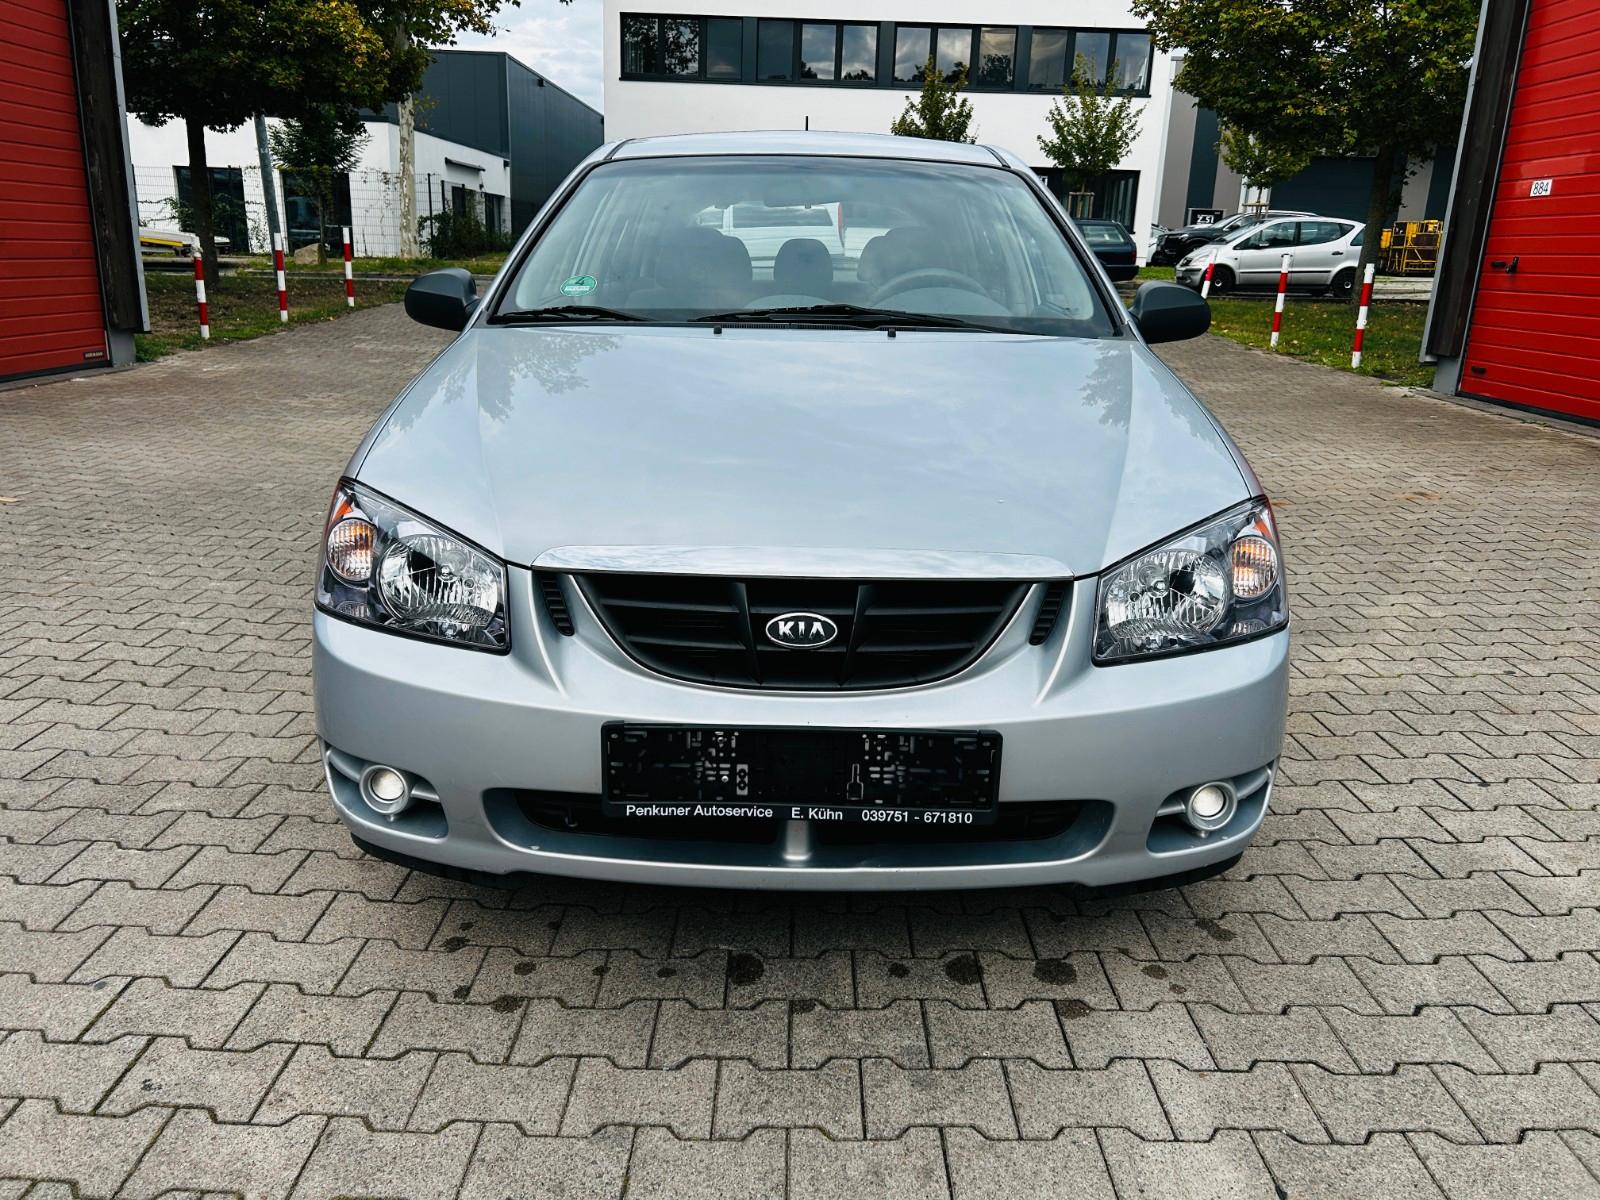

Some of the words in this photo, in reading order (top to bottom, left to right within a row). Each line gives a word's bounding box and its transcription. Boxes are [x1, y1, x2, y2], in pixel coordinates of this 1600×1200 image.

[1532, 181, 1549, 195] 884
[574, 276, 586, 286] 4
[778, 620, 827, 640] KIA
[626, 804, 691, 817] Penkuner
[694, 804, 774, 818] Autoservice
[791, 807, 804, 819] E.
[808, 807, 843, 820] Kühn
[861, 809, 909, 822] 039751
[923, 811, 973, 824] 671810
